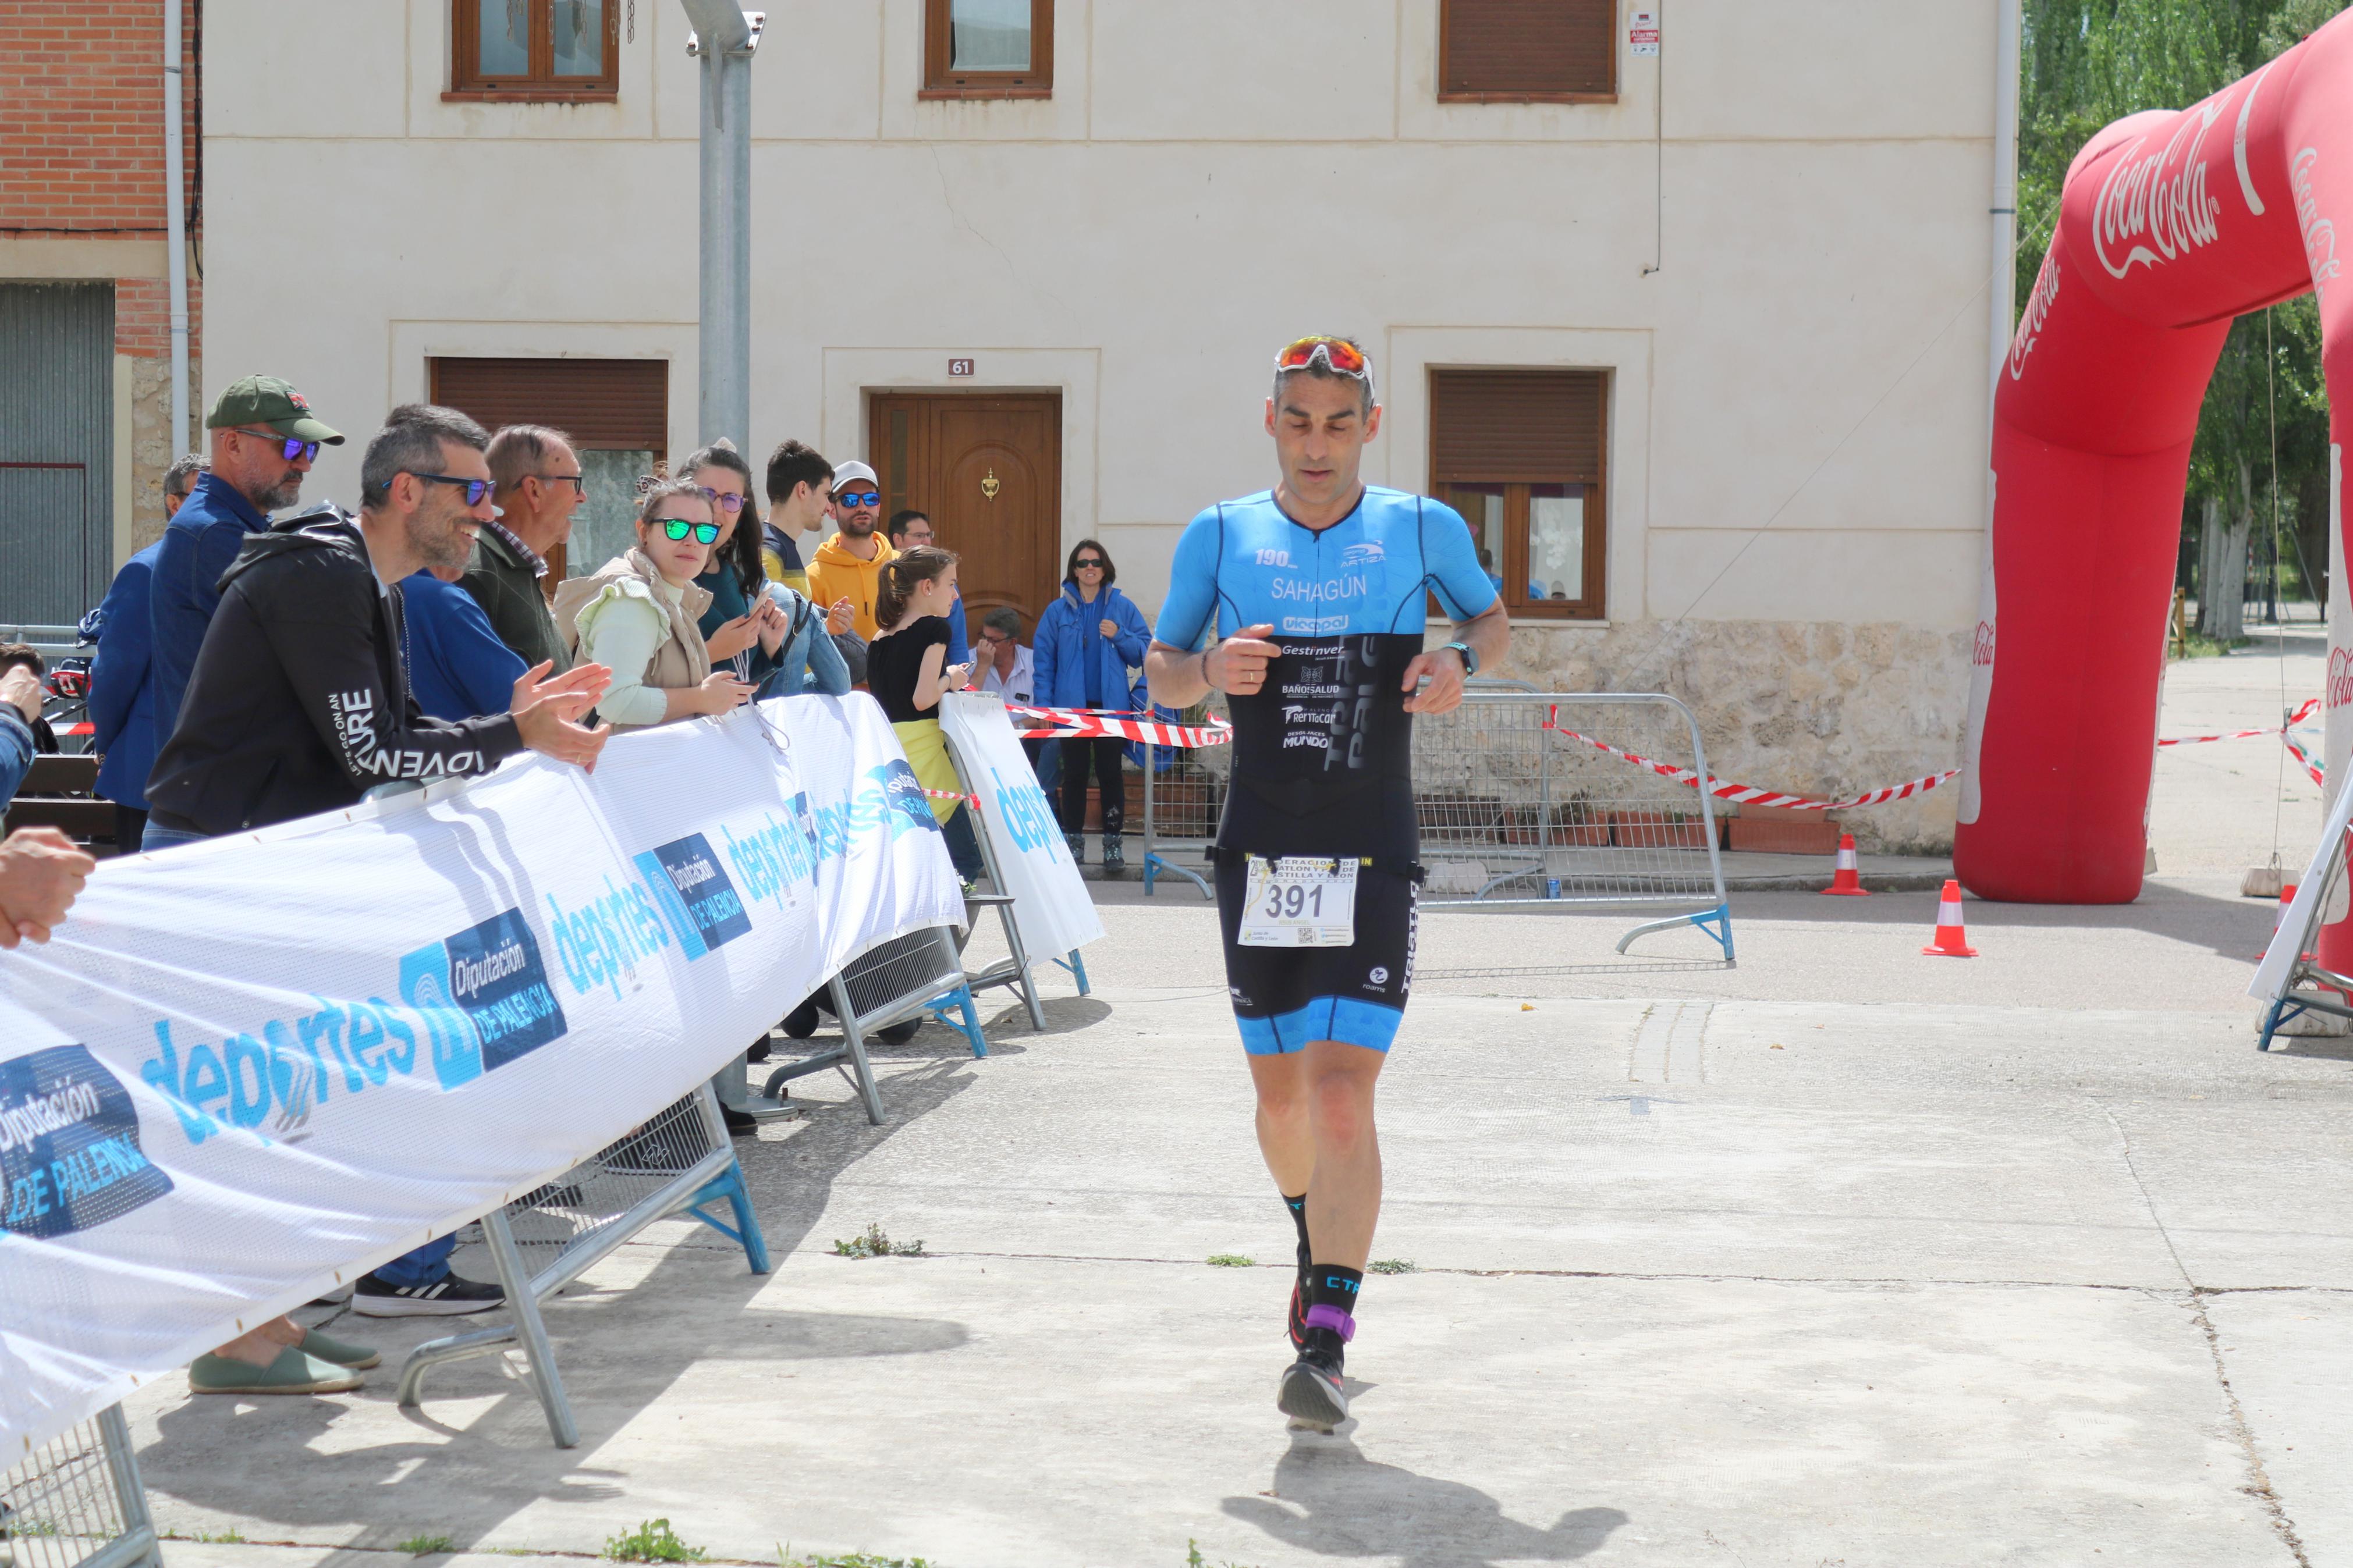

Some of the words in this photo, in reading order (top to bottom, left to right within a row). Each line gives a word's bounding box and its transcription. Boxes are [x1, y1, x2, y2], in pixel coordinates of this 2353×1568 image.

[2093, 91, 2235, 279] Coca-Cola
[952, 361, 968, 374] 61
[1255, 549, 1289, 567] 190
[1340, 555, 1386, 568] ARTIZA
[1271, 573, 1367, 602] SAHAGÚN
[328, 694, 340, 710] AN
[332, 713, 345, 729] ON
[339, 731, 350, 749] GO
[1283, 736, 1328, 748] MUNDO
[666, 854, 716, 894] Diputación
[1361, 858, 1372, 866] IN
[690, 902, 710, 930] DE
[700, 888, 744, 925] PALENCIA
[1265, 884, 1323, 918] 391
[546, 873, 669, 1001] deportes
[456, 938, 526, 998] Diputación
[1362, 984, 1386, 993] roams
[472, 1009, 502, 1044] DE
[489, 982, 558, 1034] PALENCIA
[140, 994, 416, 1146] deportes
[6, 1168, 50, 1223] DE
